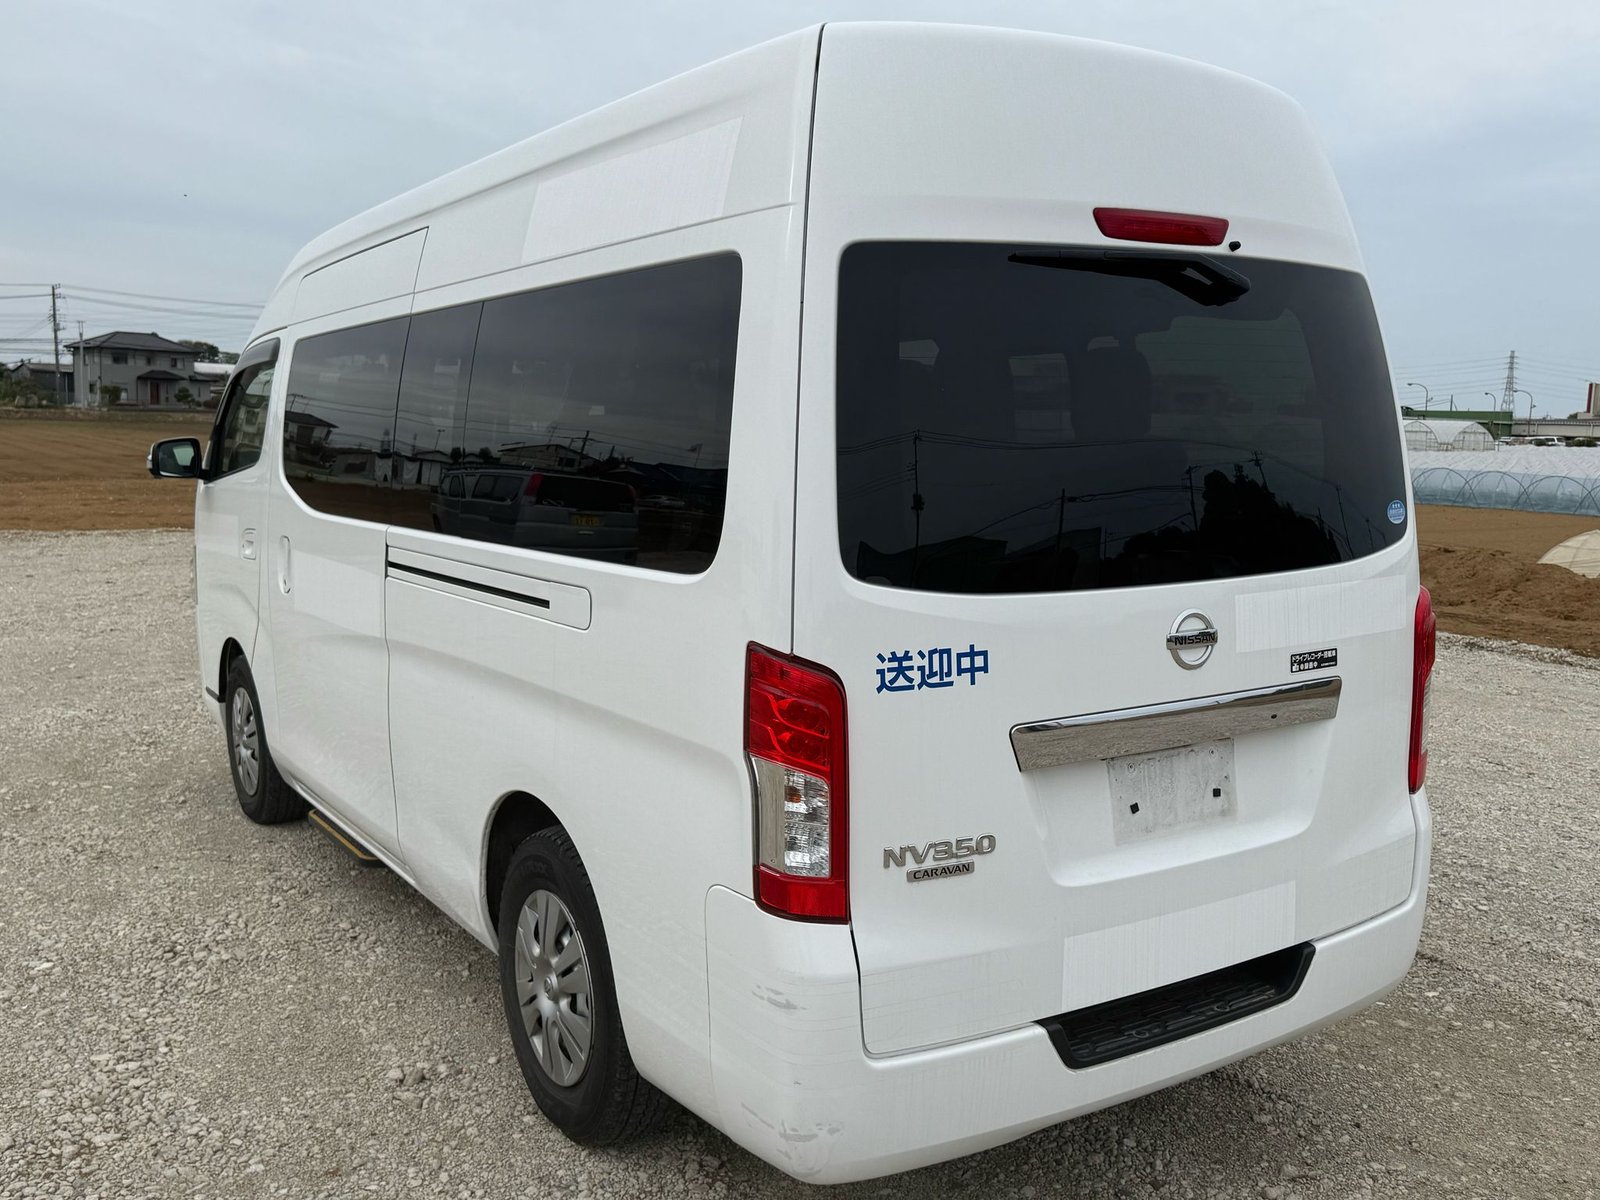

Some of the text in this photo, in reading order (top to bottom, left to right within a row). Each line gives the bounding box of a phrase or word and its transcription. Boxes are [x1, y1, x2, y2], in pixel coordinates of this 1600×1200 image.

[1174, 632, 1216, 646] NISSAN
[876, 644, 989, 694] 送迎中
[883, 833, 996, 869] NV350
[913, 863, 970, 880] CARAVAN
